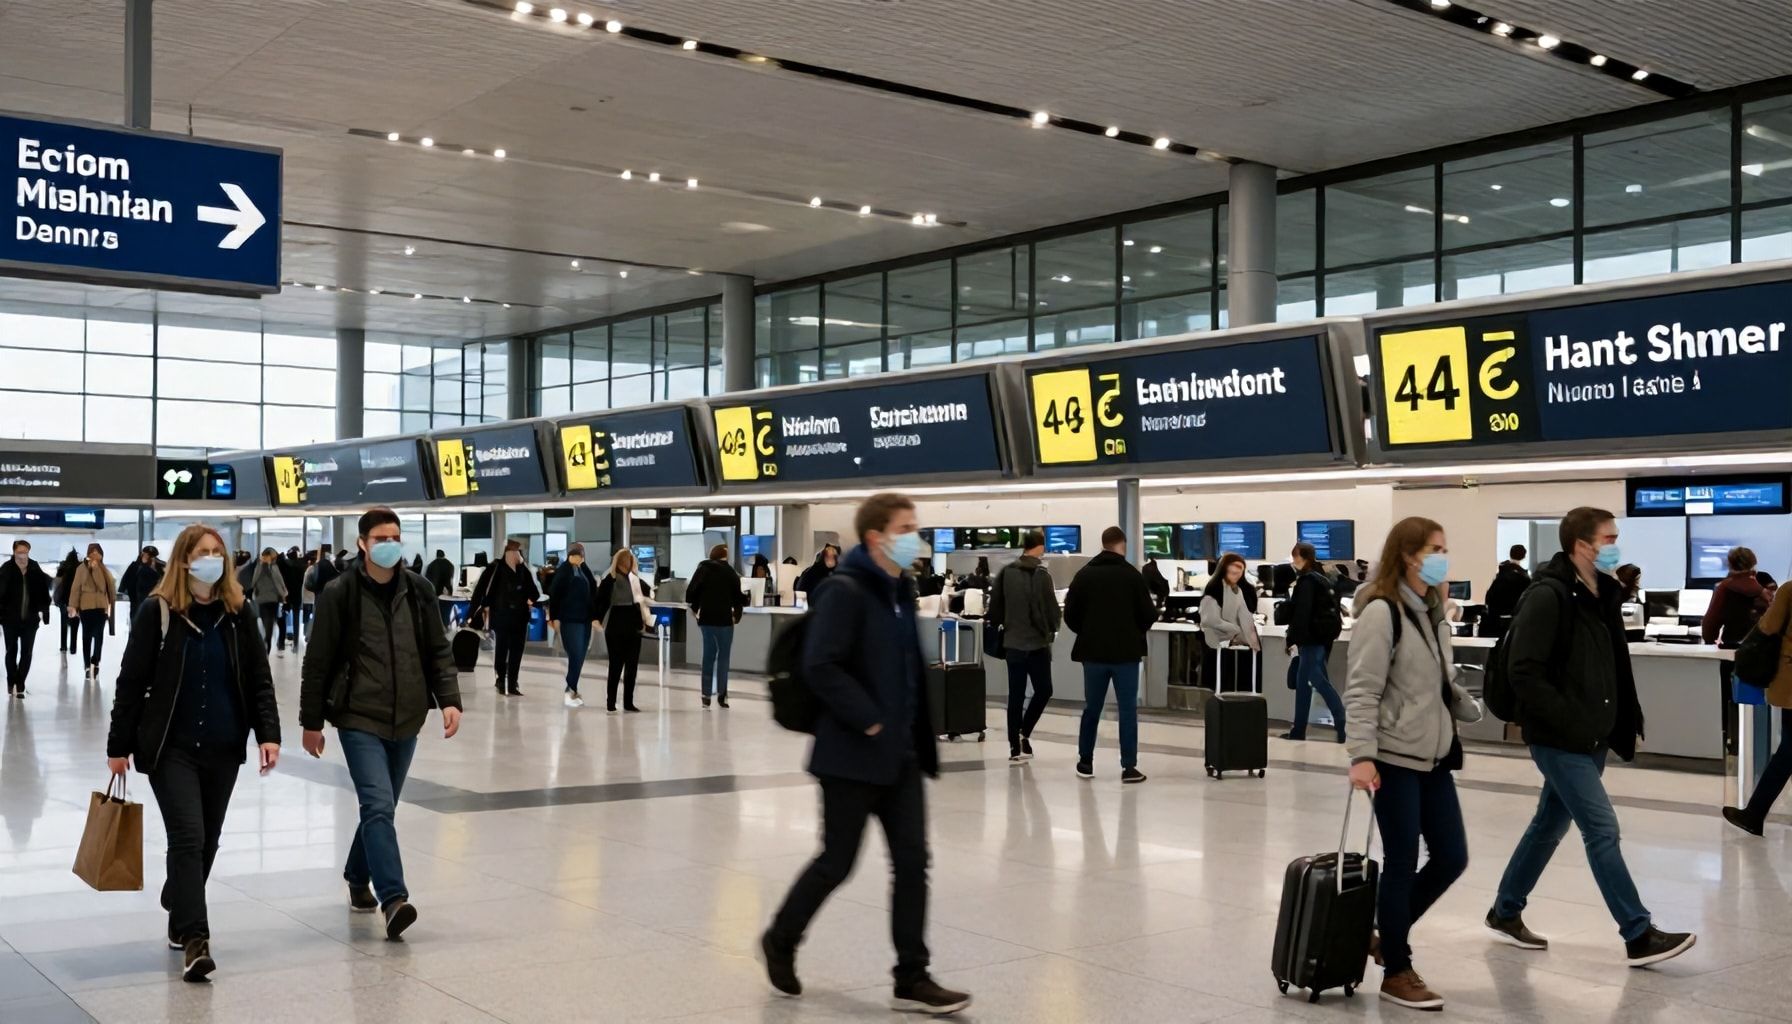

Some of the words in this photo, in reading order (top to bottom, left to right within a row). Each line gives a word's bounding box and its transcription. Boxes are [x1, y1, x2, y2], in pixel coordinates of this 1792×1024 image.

[1545, 330, 1638, 372] Hant
[1647, 322, 1786, 362] Shmer
[1394, 354, 1460, 411] 44
